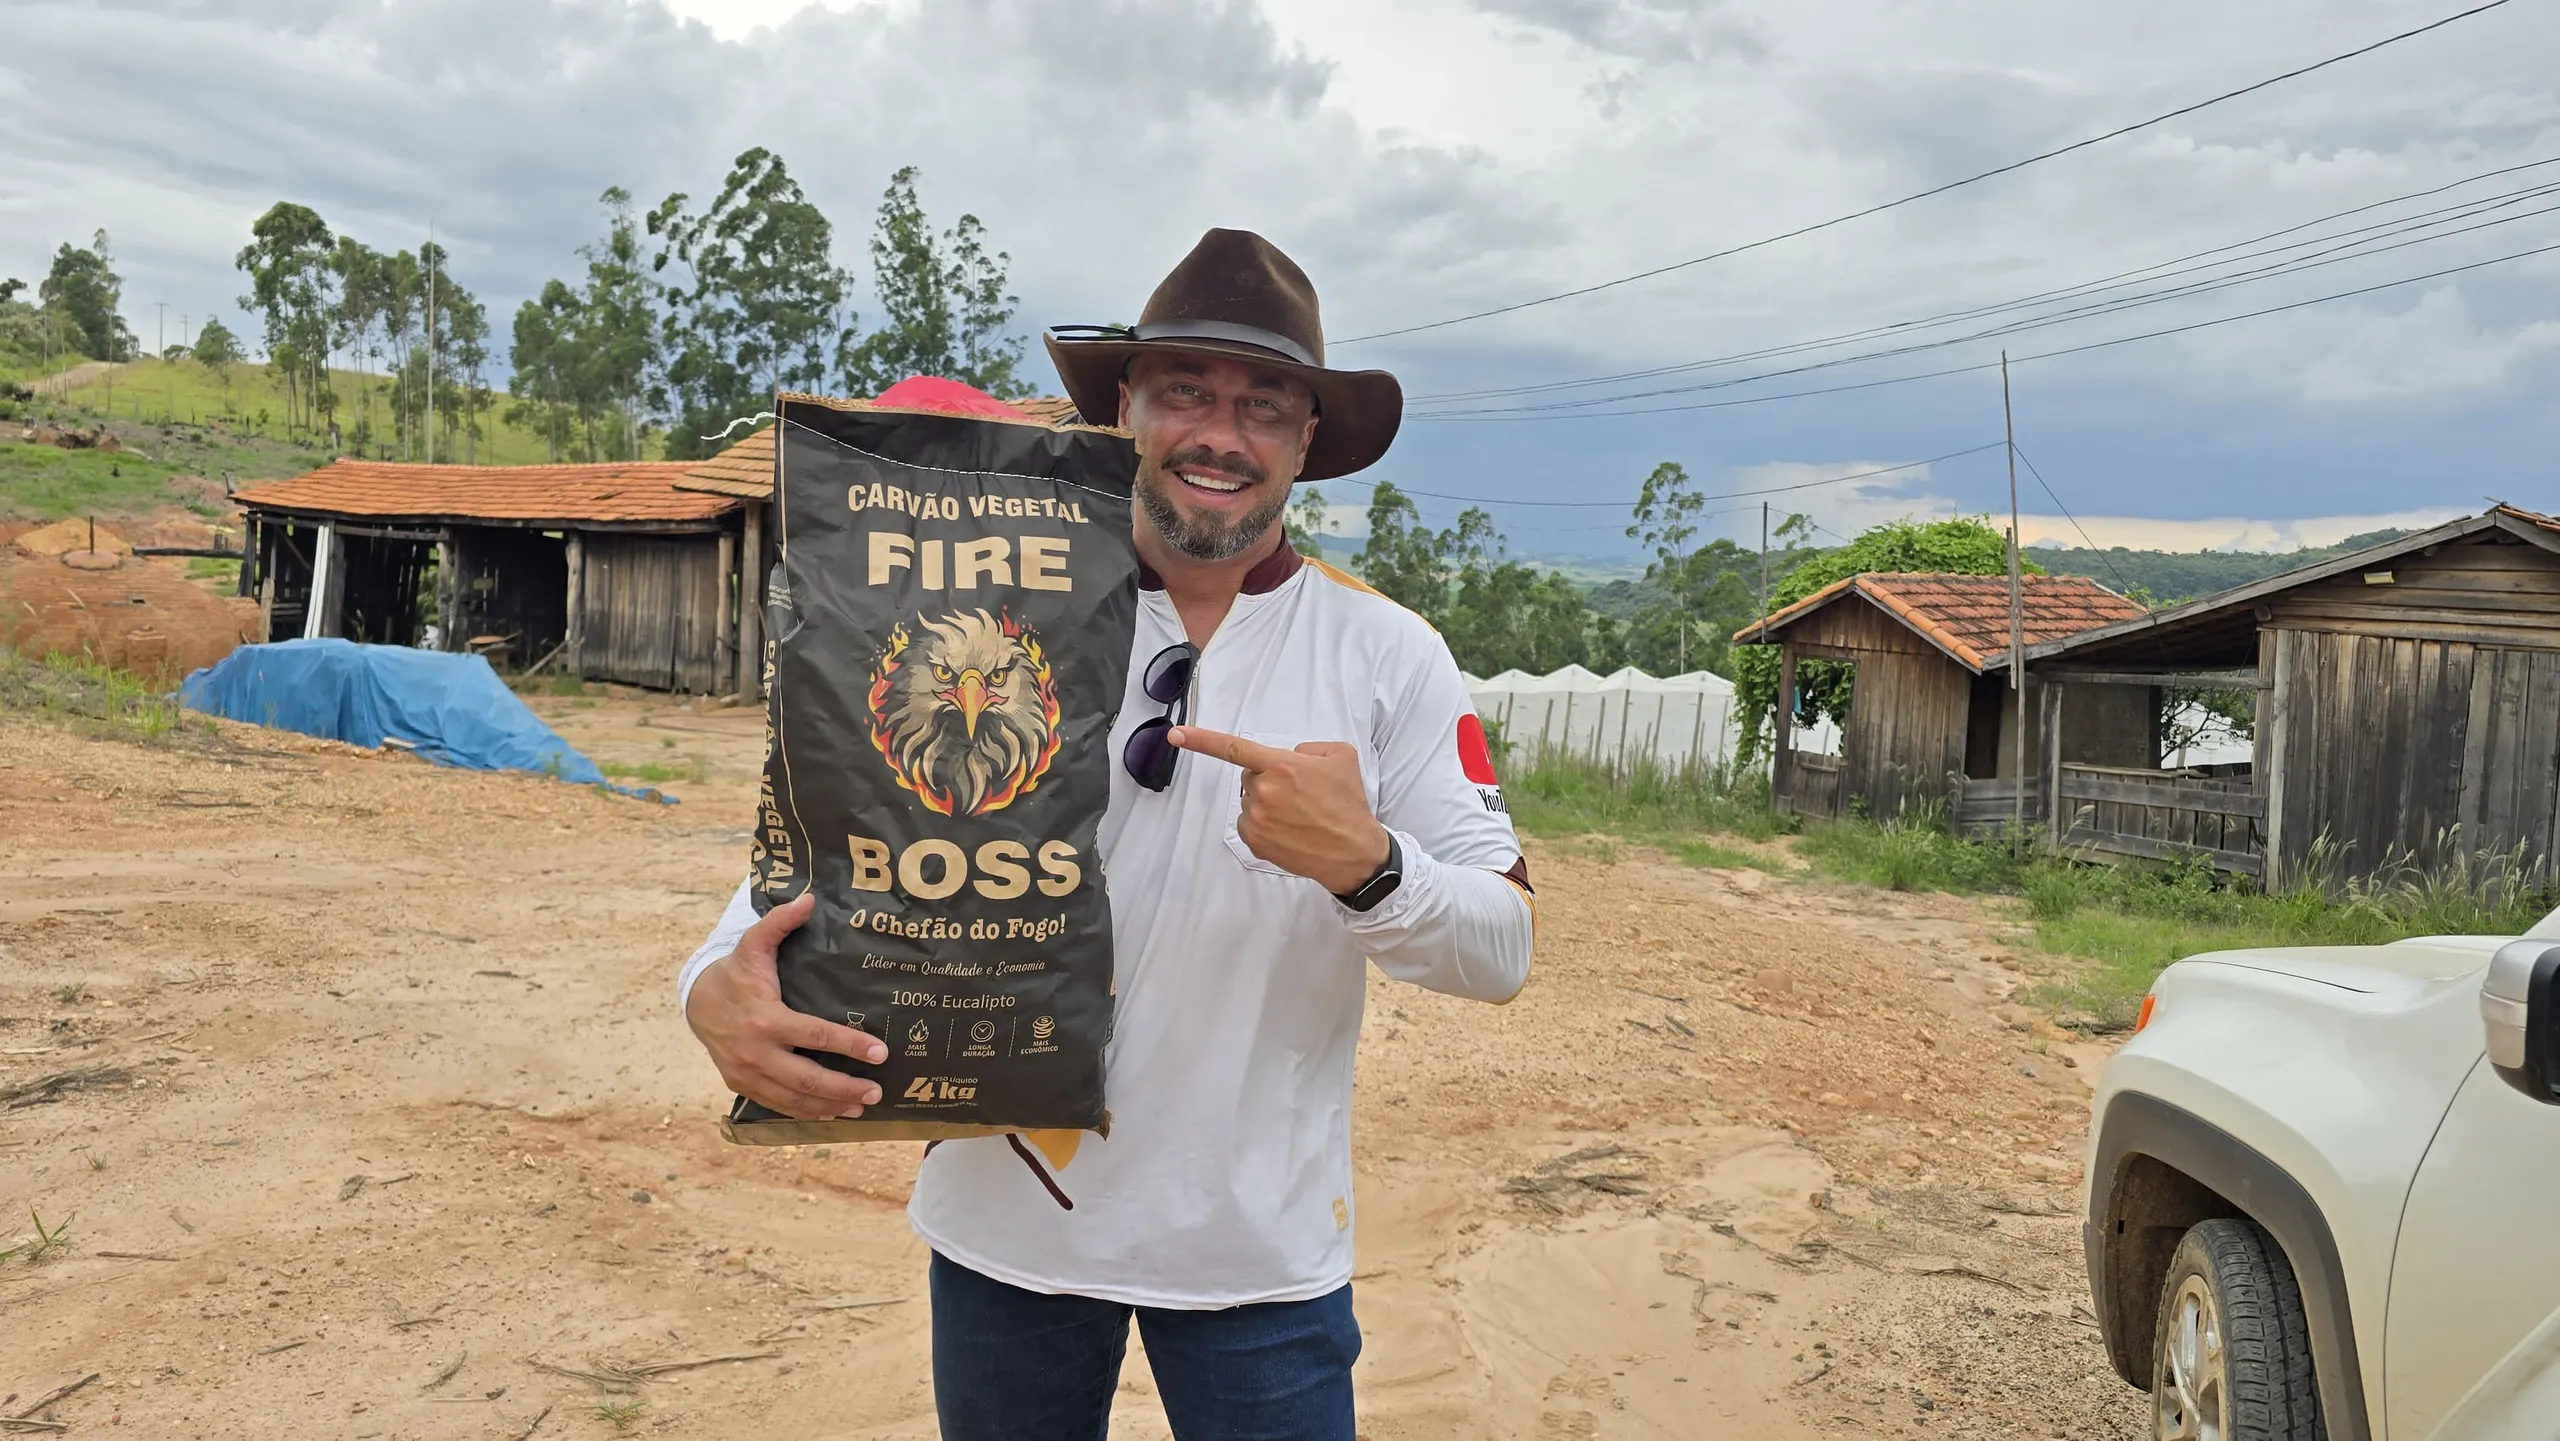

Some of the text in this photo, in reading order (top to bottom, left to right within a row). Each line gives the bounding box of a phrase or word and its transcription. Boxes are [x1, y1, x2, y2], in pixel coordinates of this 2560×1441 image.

[848, 483, 1090, 524] CARVÃO VEGETAL
[868, 532, 1073, 592] FIRE
[848, 834, 1082, 901] BOSS
[871, 912, 962, 940] Chefão
[969, 919, 1000, 940] do
[1006, 914, 1067, 943] Fogo!
[862, 953, 1046, 977] Líder em Qualidade e Economia
[891, 990, 1016, 1011] 100% Eucalipto
[962, 1049, 996, 1058] DURAÇÃO
[1020, 1044, 1059, 1056] ECONÔMICO
[949, 1076, 978, 1084] LÍQUIDO
